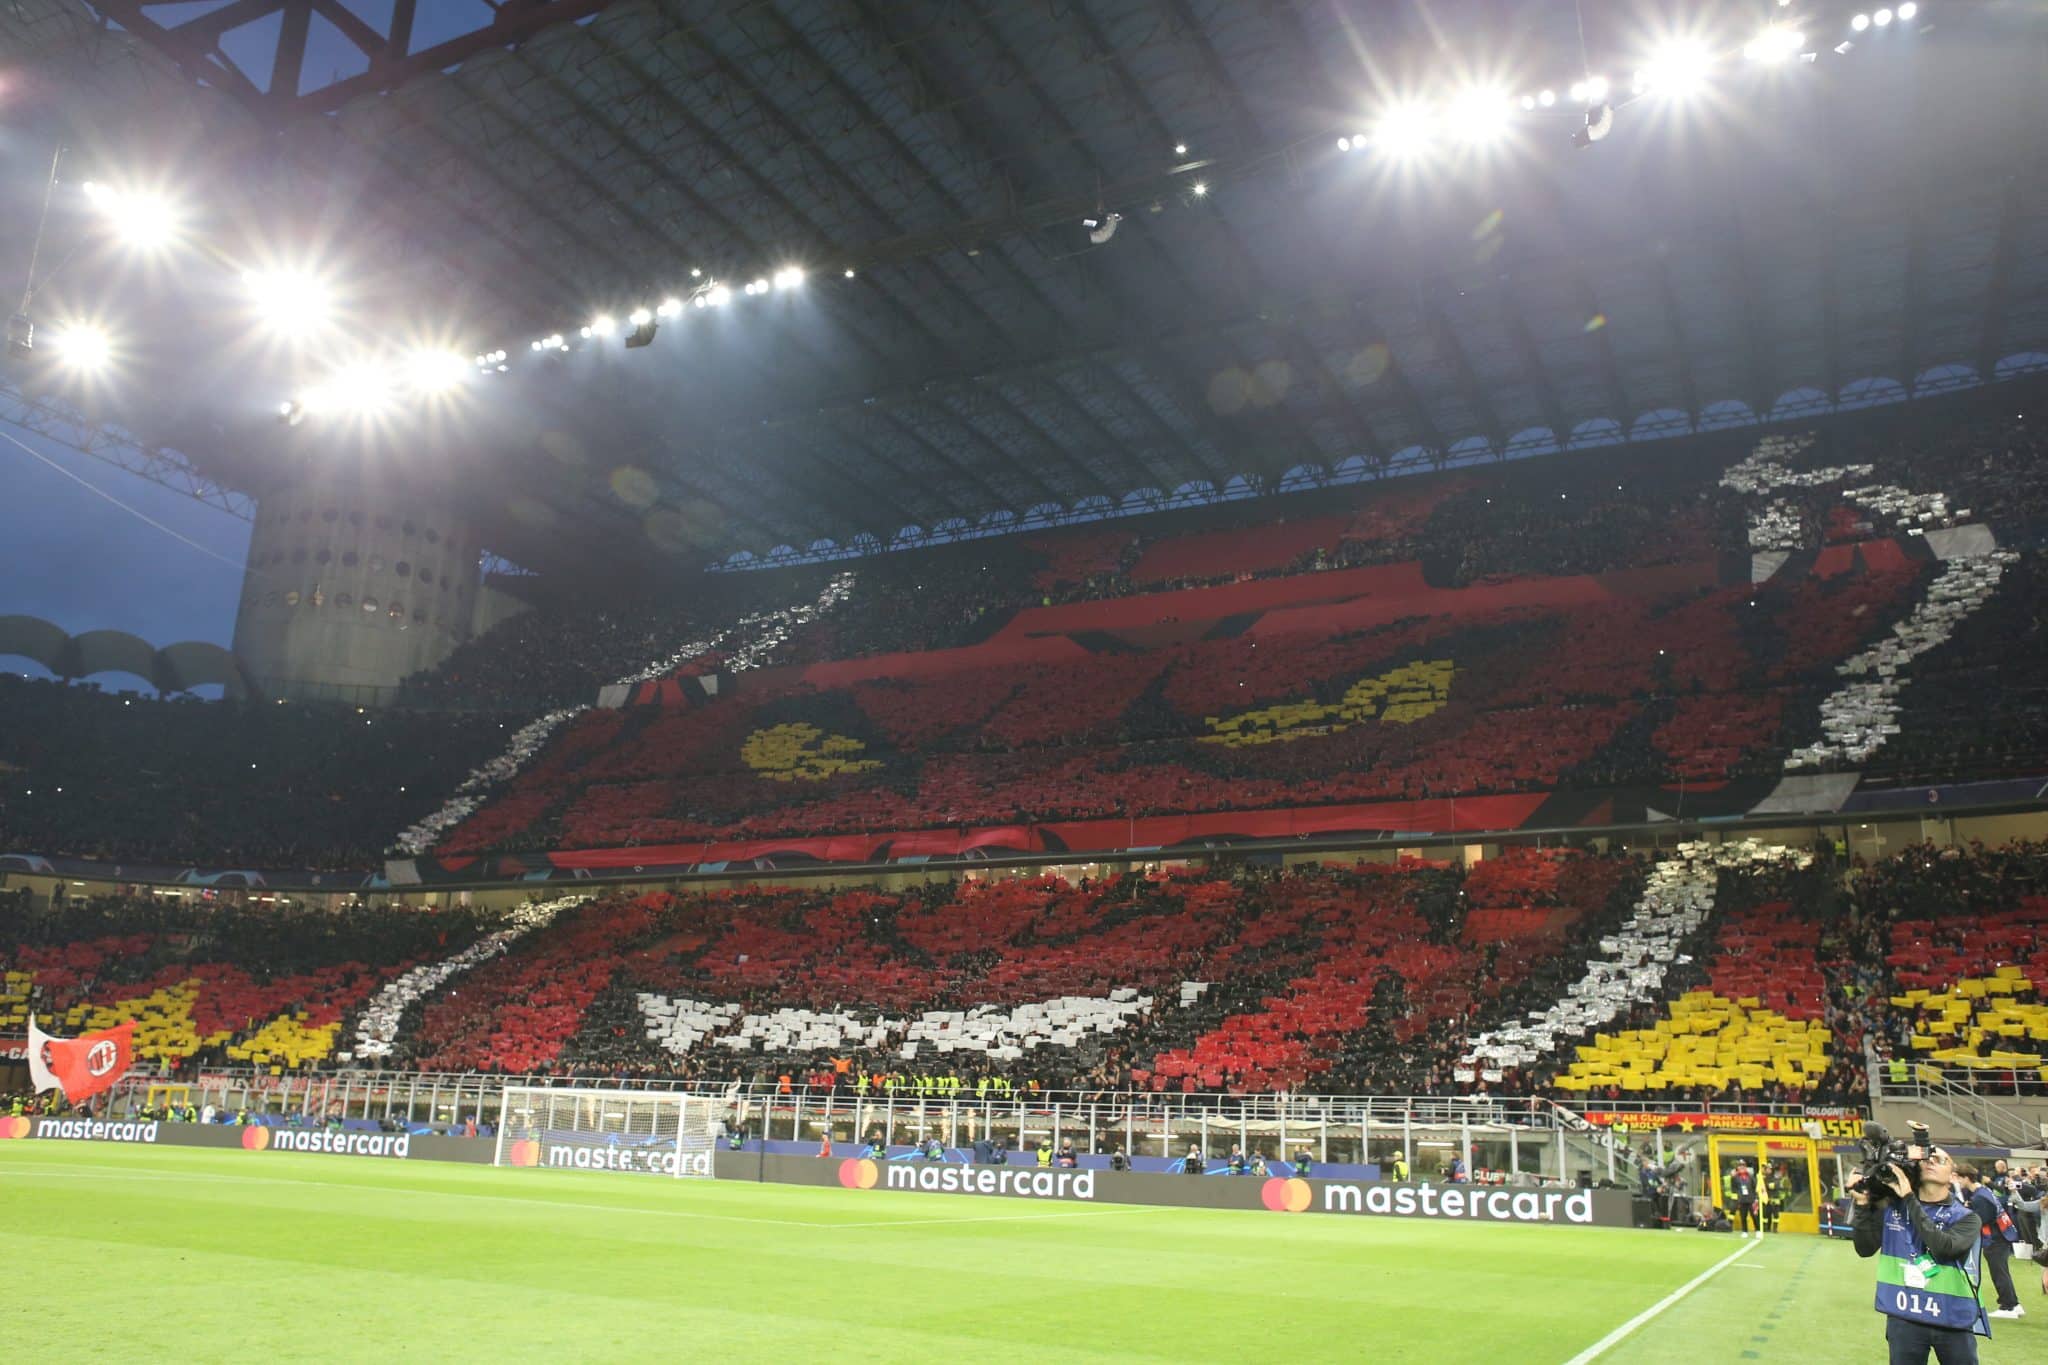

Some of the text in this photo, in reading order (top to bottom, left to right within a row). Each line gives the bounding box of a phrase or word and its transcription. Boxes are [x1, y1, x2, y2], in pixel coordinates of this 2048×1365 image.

[37, 1118, 158, 1142] mastercard
[1603, 1112, 1638, 1121] MAN
[1702, 1119, 1761, 1130] PIANEZZA
[273, 1128, 410, 1157] mastercard
[549, 1144, 710, 1175] mastercard
[887, 1163, 1095, 1199] mastercard
[1324, 1182, 1593, 1222] mastercard
[1896, 1290, 1941, 1317] 014
